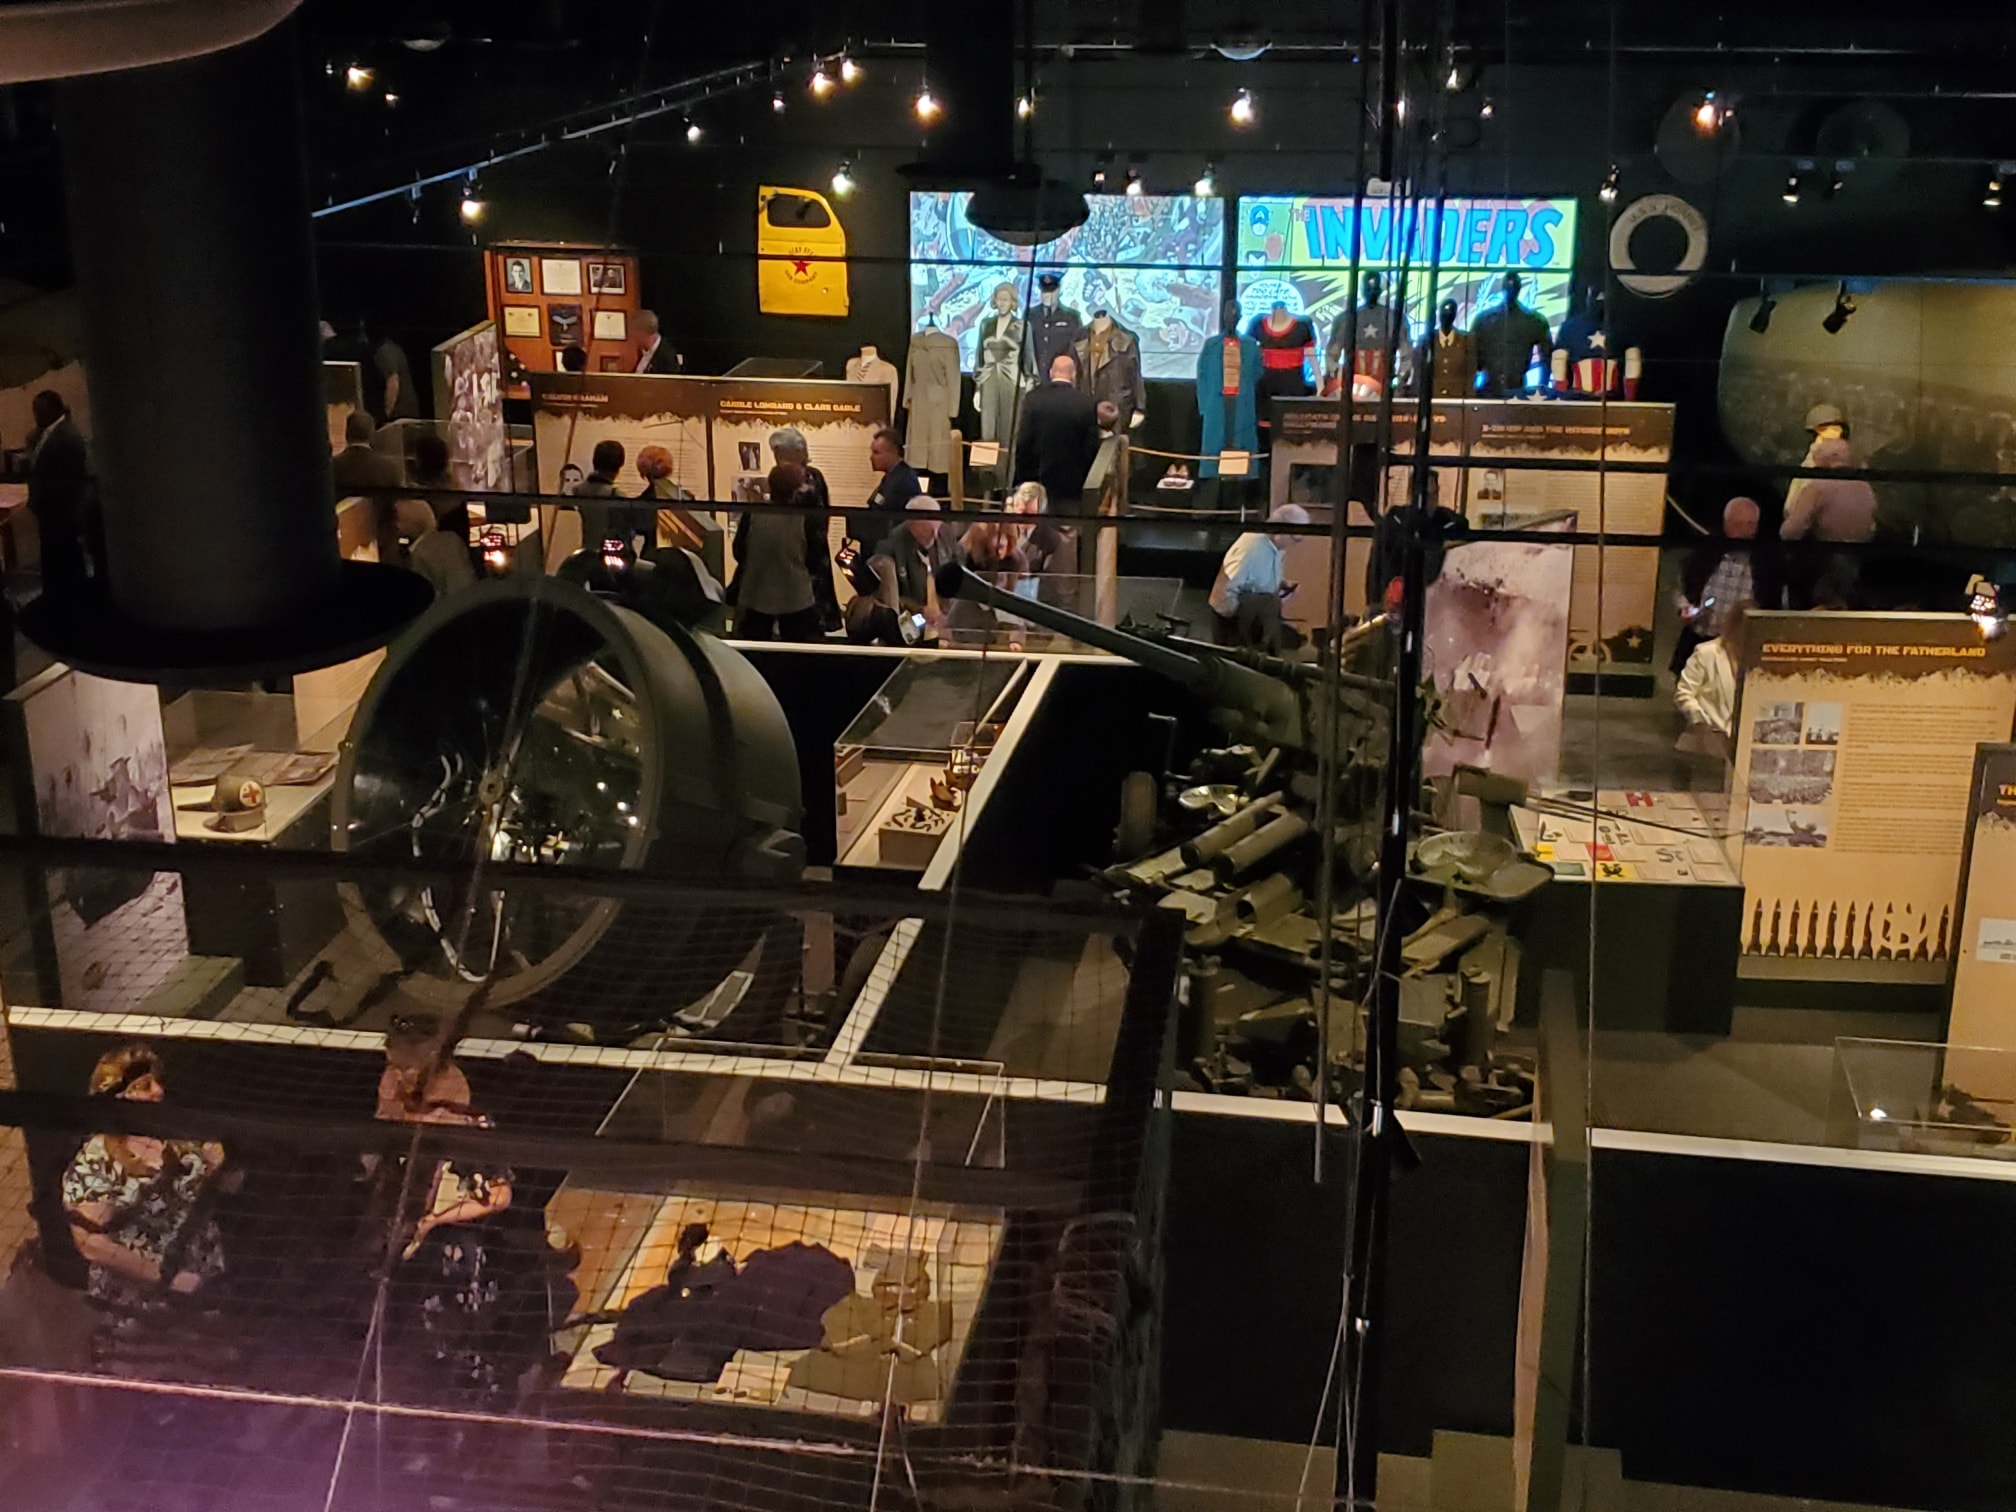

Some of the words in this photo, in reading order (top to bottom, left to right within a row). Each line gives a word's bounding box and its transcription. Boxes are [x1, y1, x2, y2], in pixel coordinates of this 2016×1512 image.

[1303, 205, 1564, 268] INVADERS
[1762, 643, 1843, 655] EVERYTHING
[1846, 645, 1872, 655] FOR
[1875, 645, 1900, 656] THE
[1902, 646, 1986, 657] FATHERLAND
